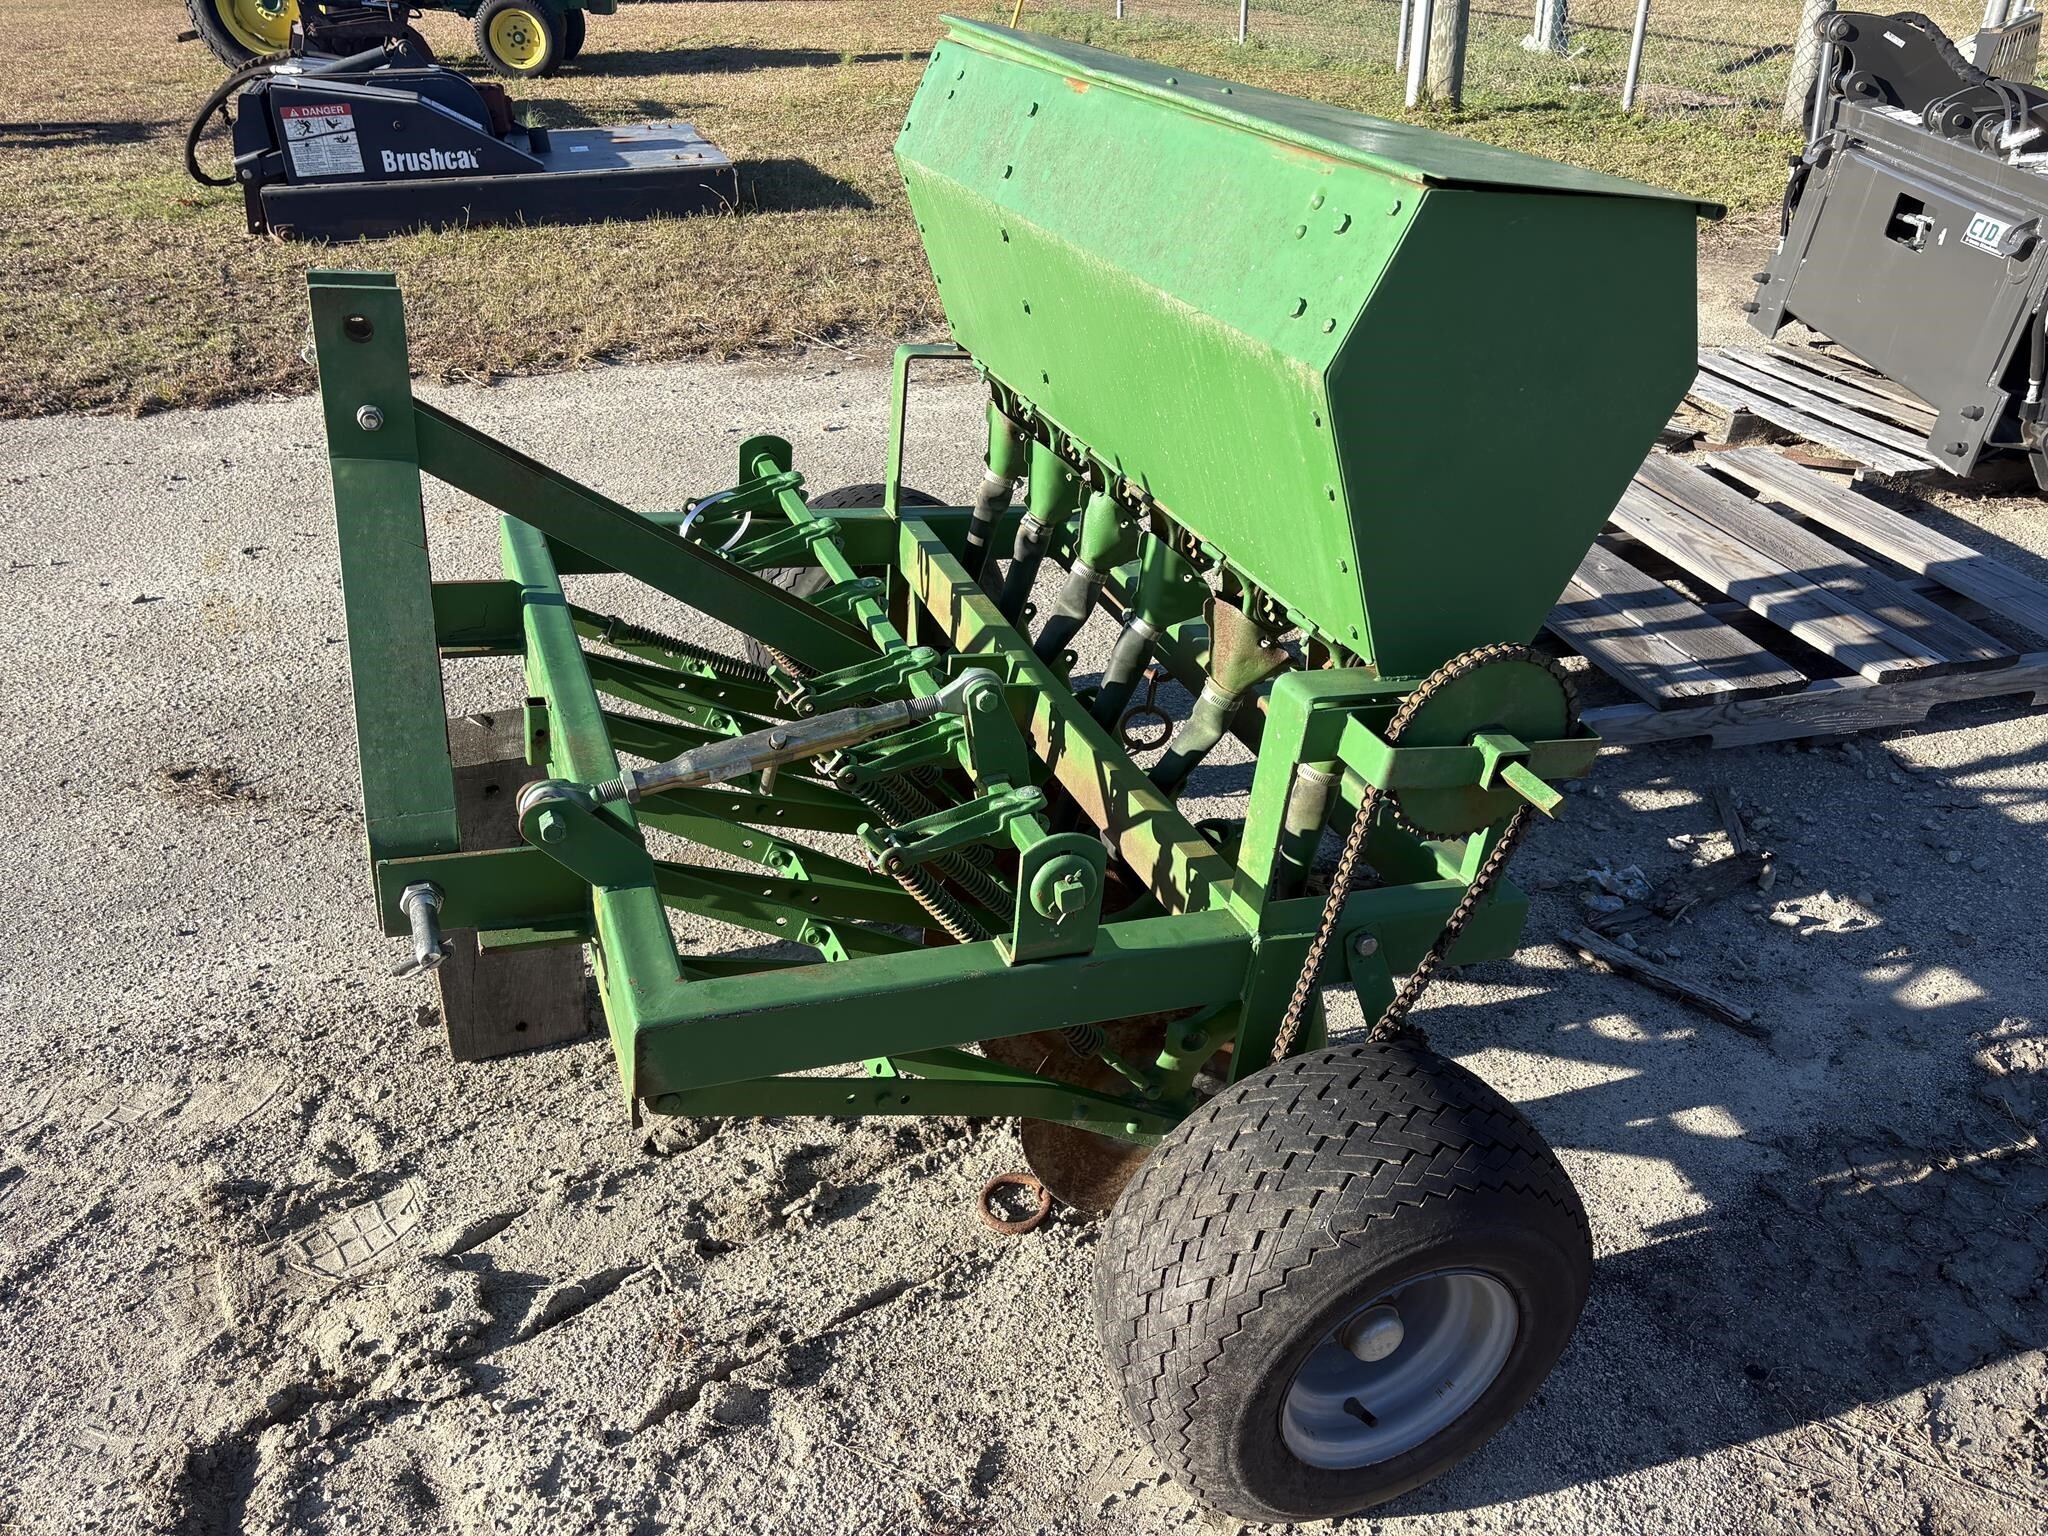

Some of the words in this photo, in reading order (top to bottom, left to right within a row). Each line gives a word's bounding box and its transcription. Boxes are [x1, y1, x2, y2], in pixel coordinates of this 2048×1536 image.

[302, 105, 344, 116] DANGER
[381, 148, 480, 173] Brushcat
[1969, 218, 2000, 242] CID
